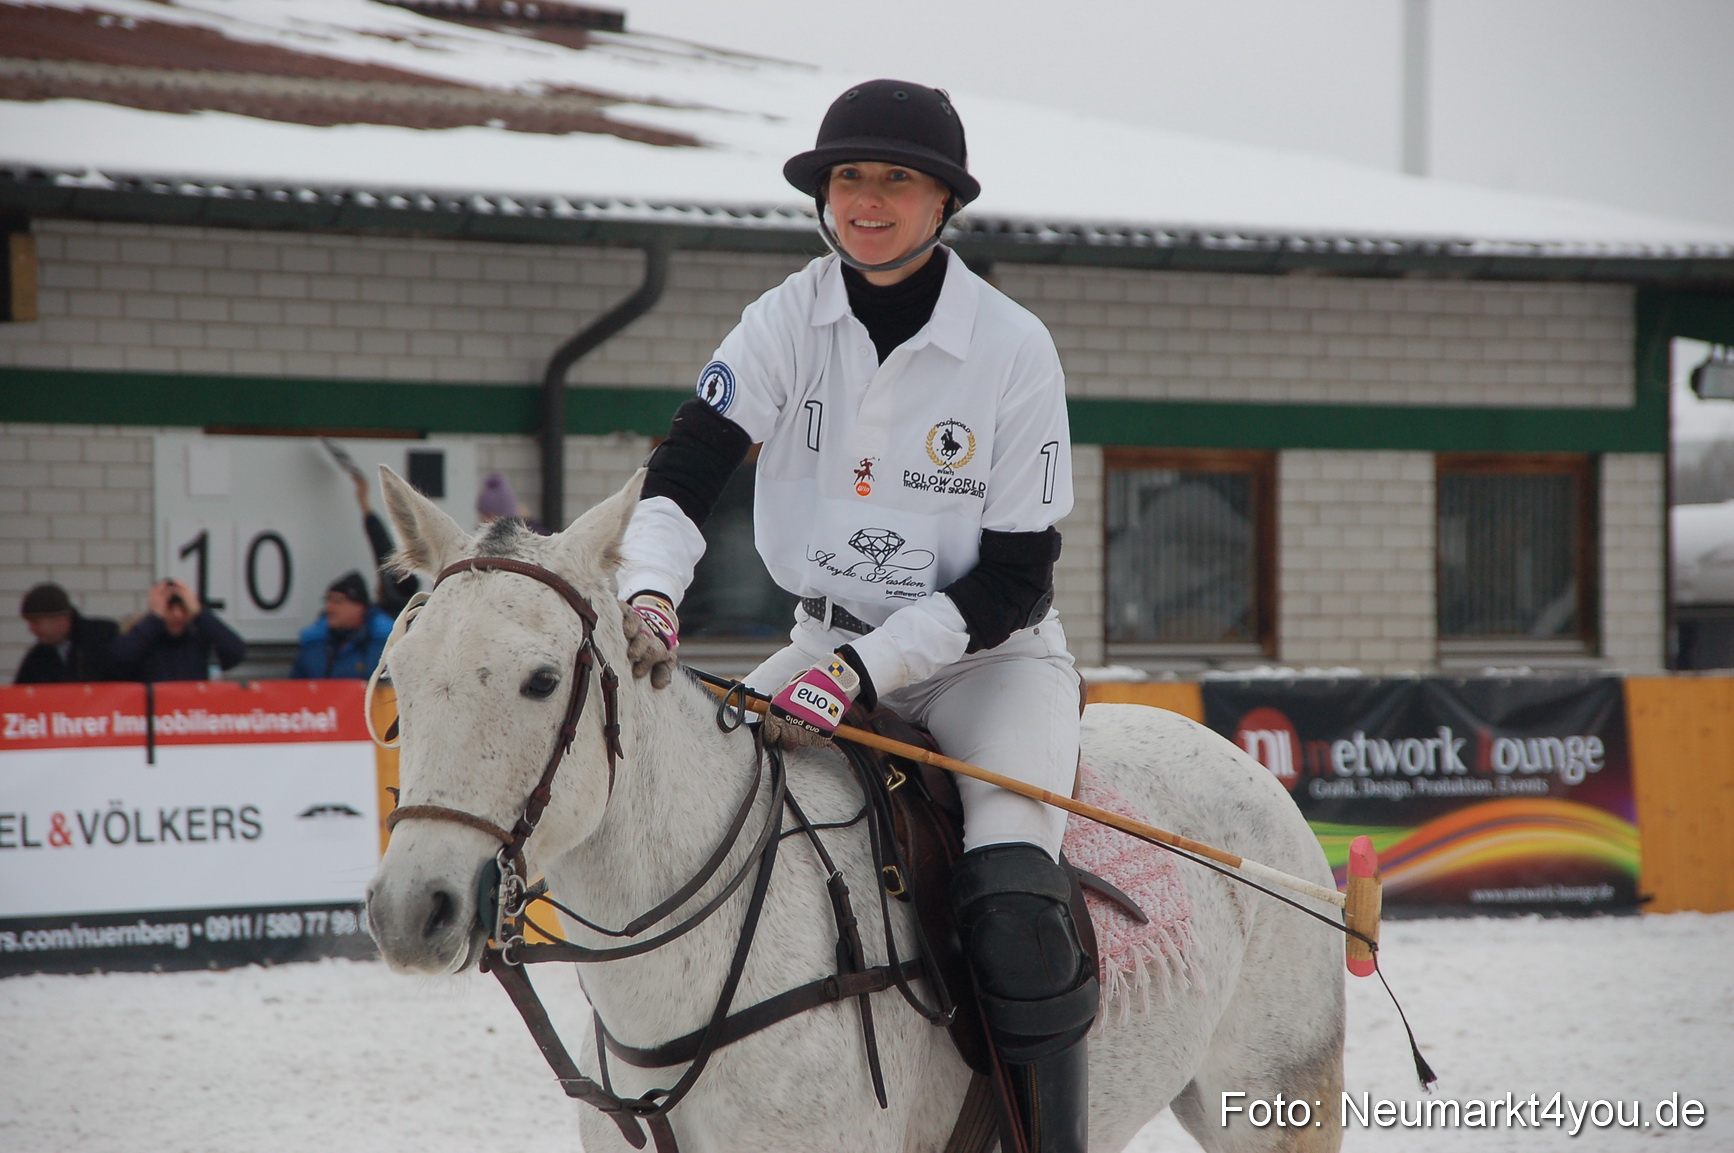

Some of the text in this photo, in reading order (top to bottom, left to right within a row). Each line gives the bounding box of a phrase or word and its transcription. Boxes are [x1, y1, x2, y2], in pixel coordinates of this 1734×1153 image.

[804, 400, 823, 452] 1
[903, 481, 984, 499] TROPHY ON SNOW 2013
[1041, 441, 1059, 504] 1
[180, 530, 292, 611] 10
[797, 688, 828, 709] ona
[3, 712, 47, 739] Ziel
[51, 711, 108, 737] Ihrer
[1305, 725, 1467, 776] network
[1474, 728, 1605, 785] lounge
